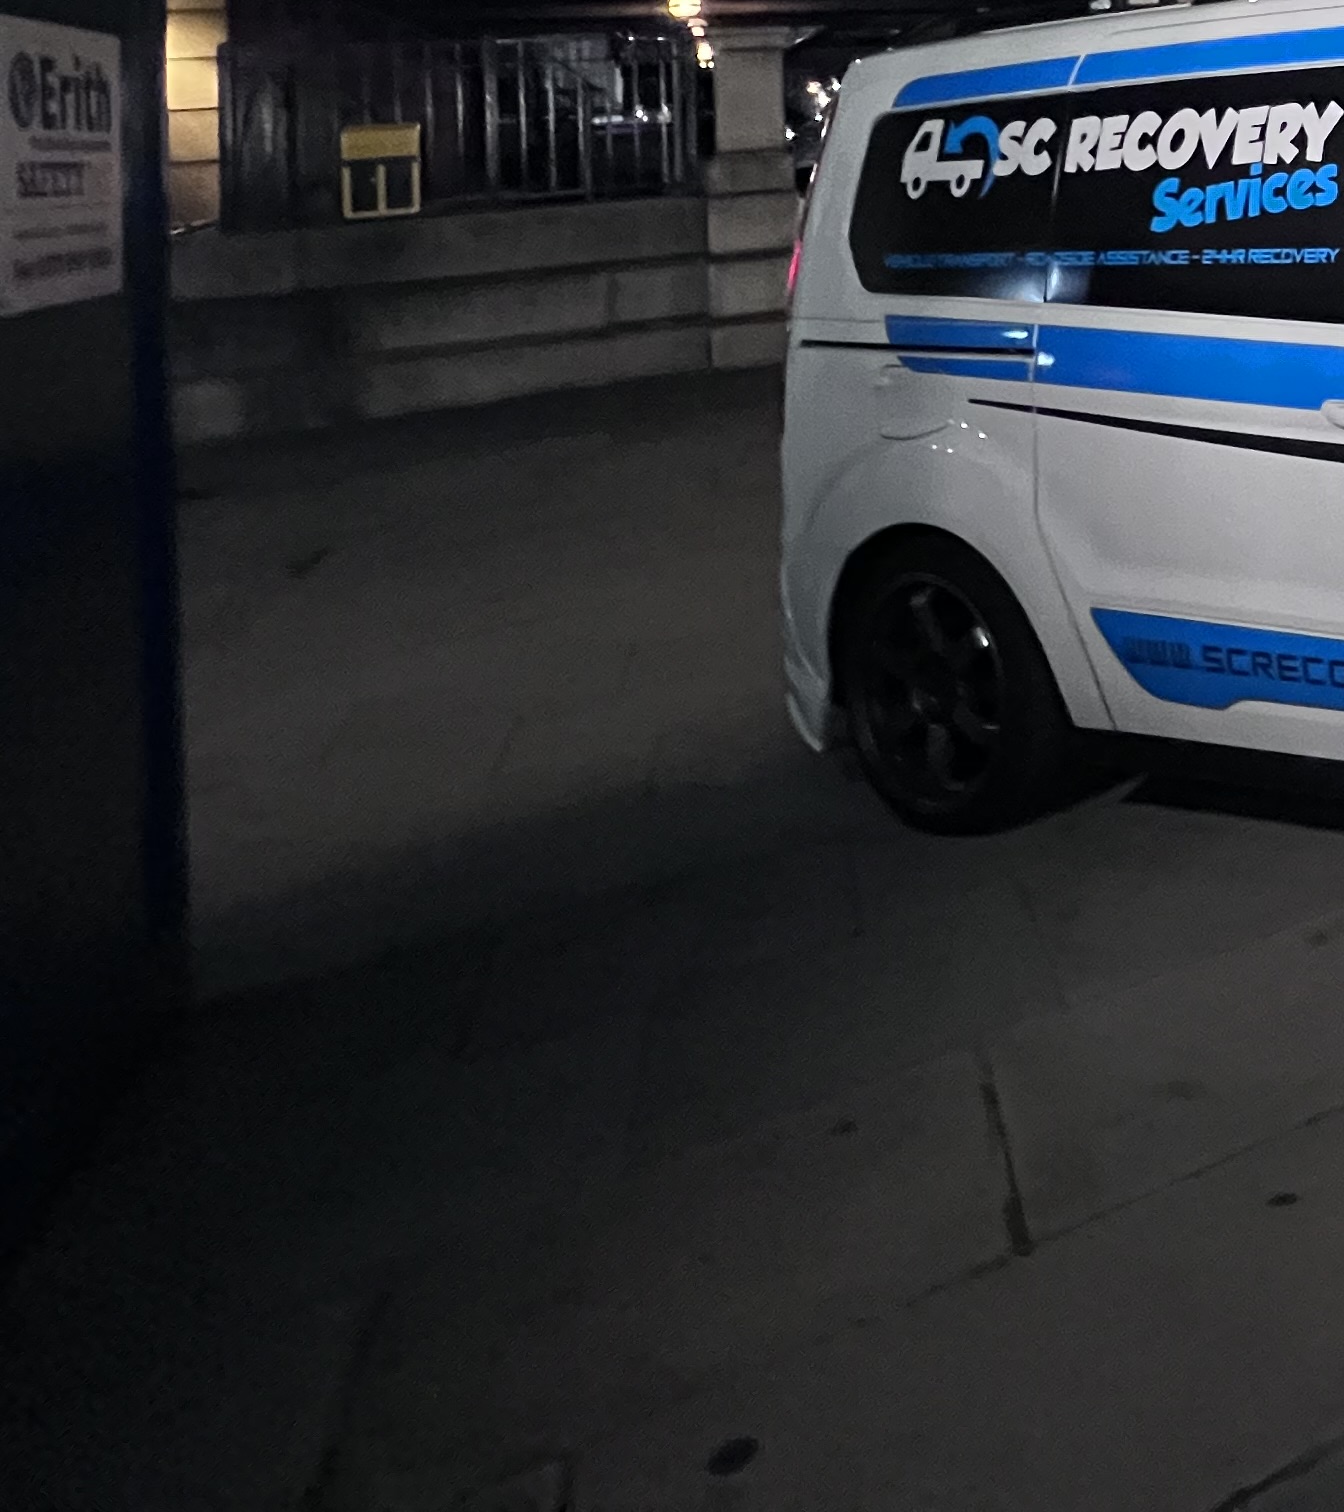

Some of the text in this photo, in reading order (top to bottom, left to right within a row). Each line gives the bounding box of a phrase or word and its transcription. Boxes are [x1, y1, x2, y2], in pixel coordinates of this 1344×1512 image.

[993, 100, 1344, 176] SC RECOVERY
[1150, 161, 1339, 233] Services
[1099, 250, 1190, 266] ASSISTANCE
[1247, 247, 1341, 265] RECOVERY
